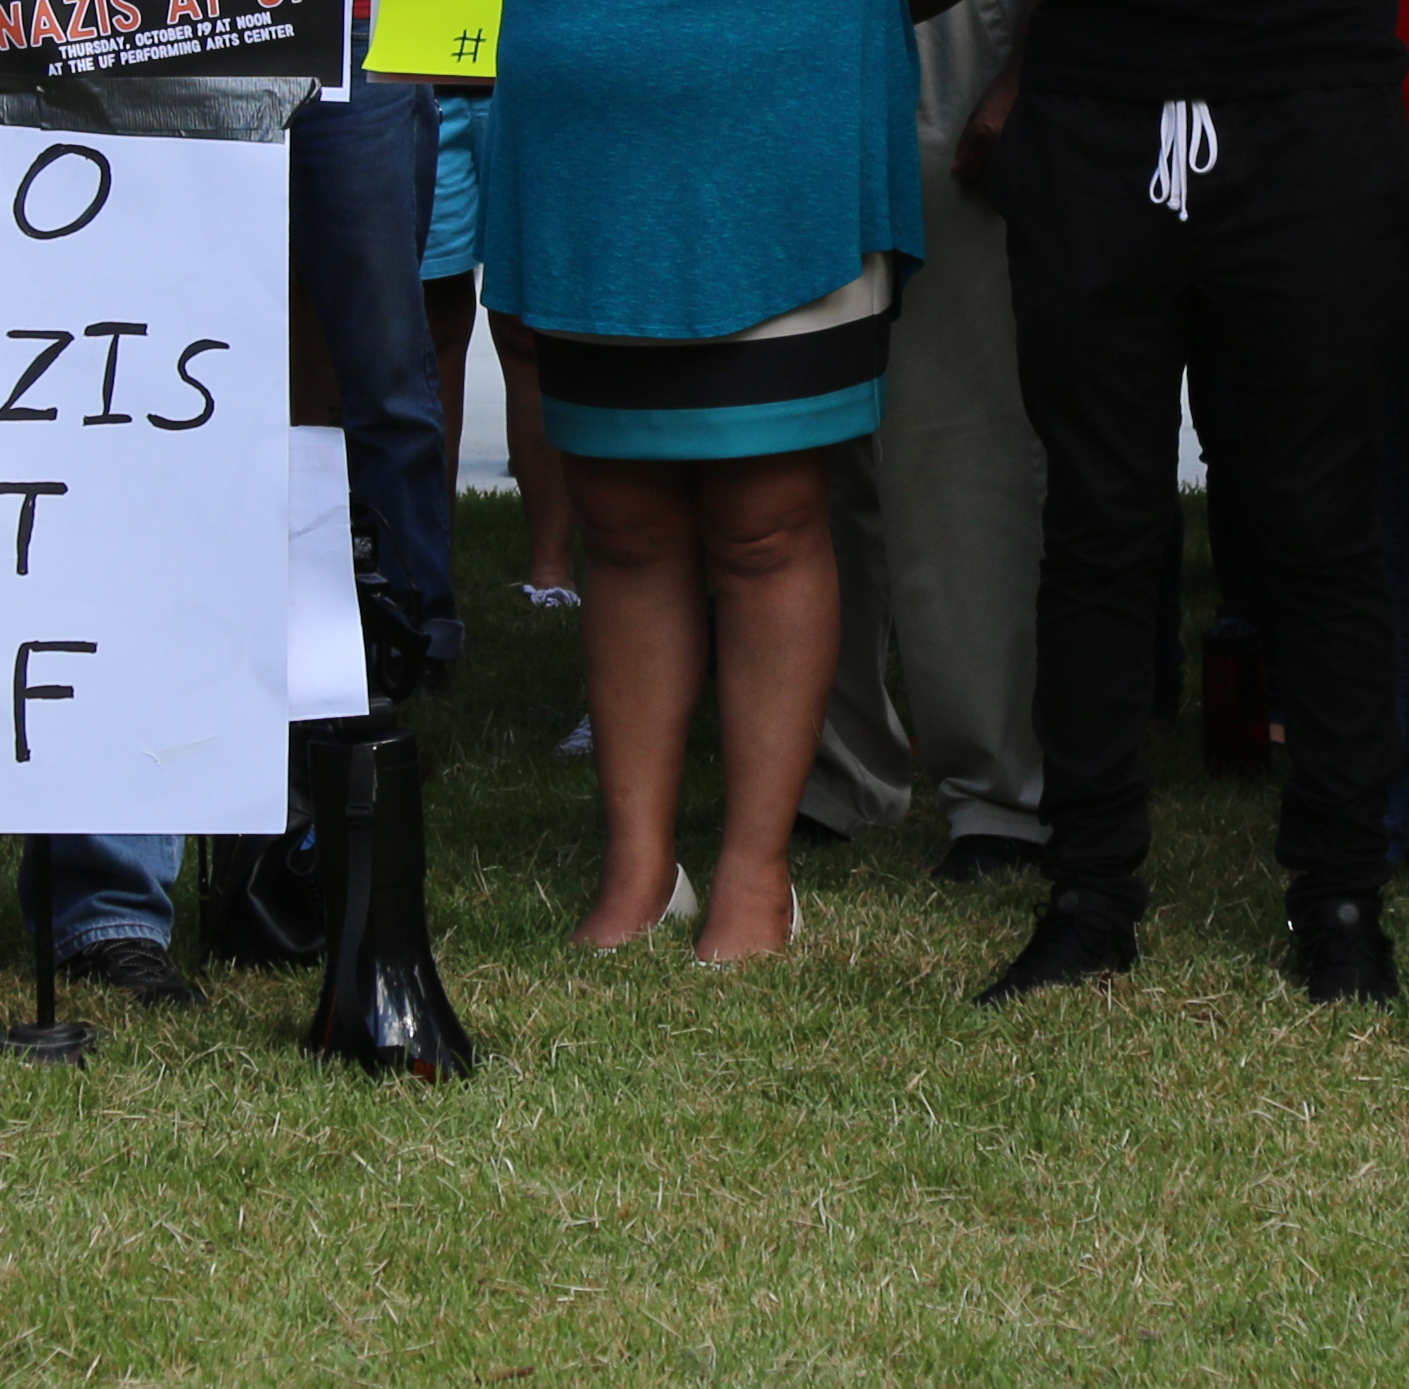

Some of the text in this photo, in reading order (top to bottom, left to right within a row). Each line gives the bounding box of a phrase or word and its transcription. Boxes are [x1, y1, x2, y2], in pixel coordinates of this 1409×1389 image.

[48, 23, 296, 77] AT THE UF PERFORMING ARTS CENTER
[59, 11, 272, 60] THURSDAY, OCTOBER 19 AT NOON
